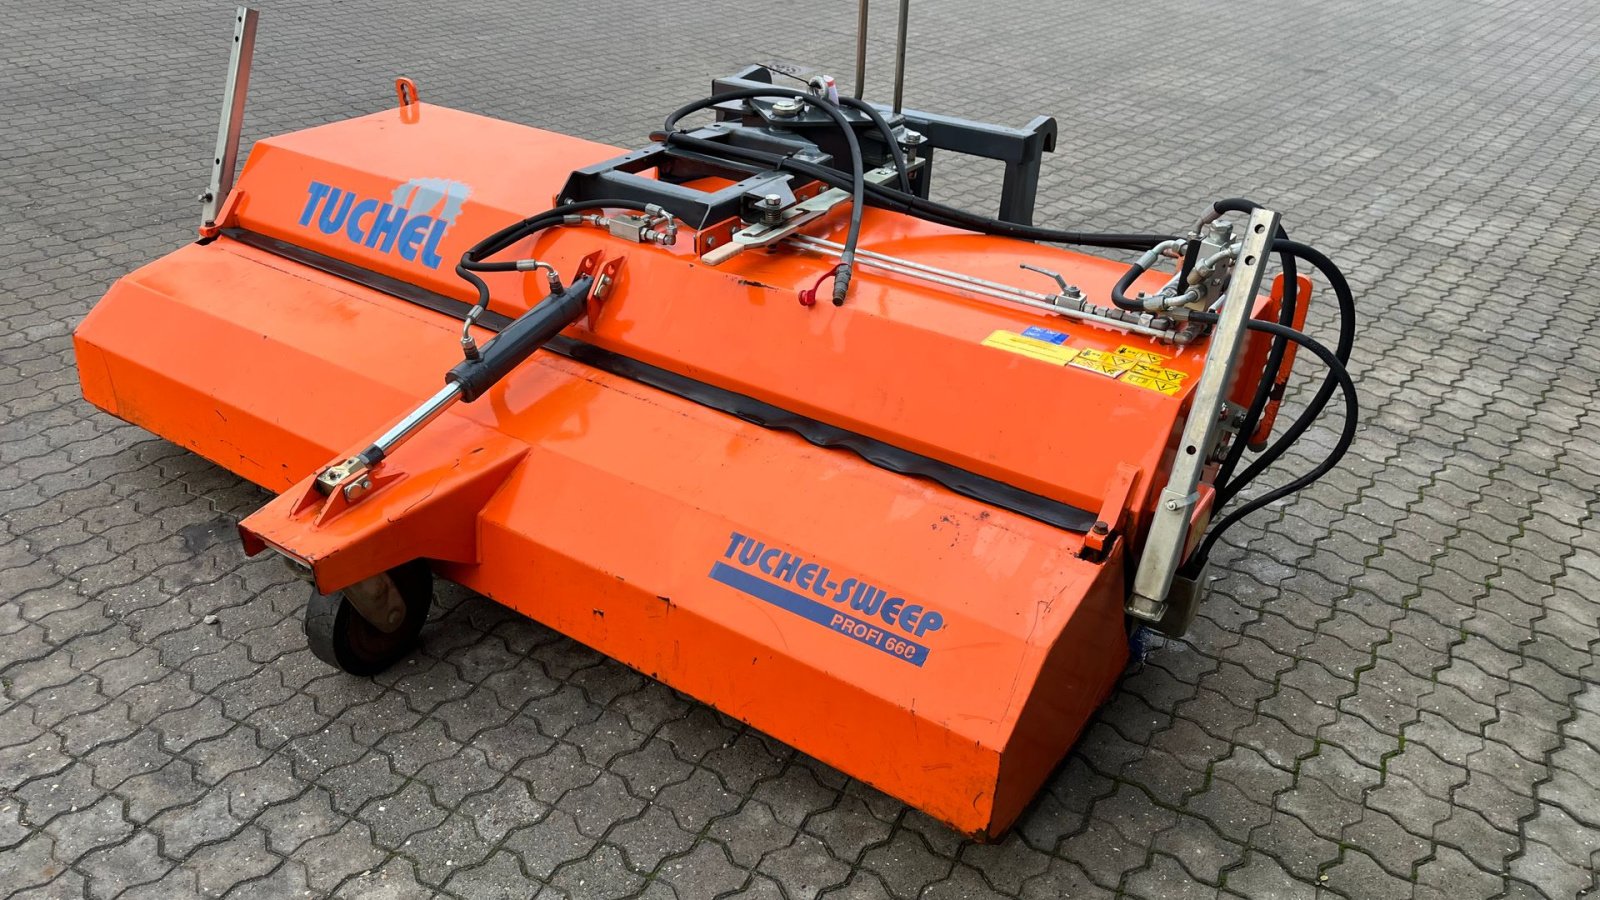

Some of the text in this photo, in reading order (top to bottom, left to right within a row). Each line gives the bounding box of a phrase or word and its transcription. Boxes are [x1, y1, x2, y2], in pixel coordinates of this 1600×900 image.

[298, 181, 449, 270] TUCHEL
[723, 531, 944, 638] TUCHEL-SWEEP
[830, 613, 916, 659] PROFI 660
